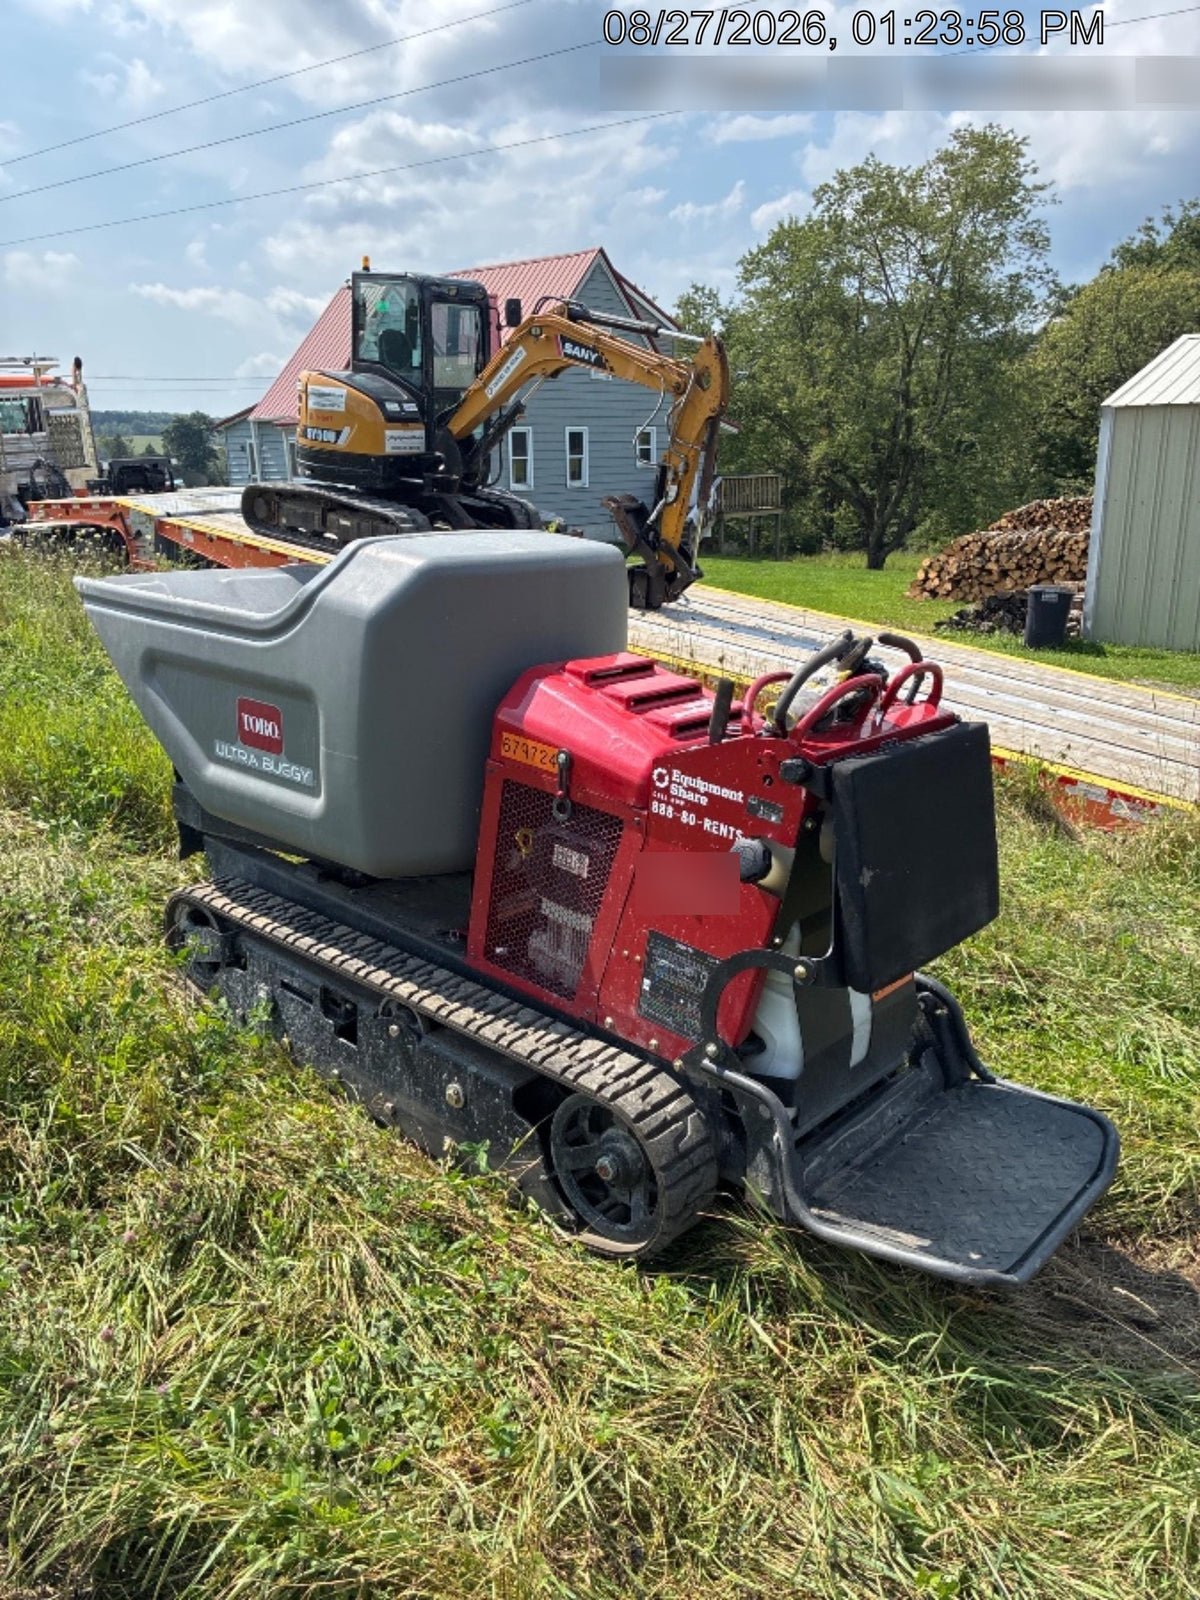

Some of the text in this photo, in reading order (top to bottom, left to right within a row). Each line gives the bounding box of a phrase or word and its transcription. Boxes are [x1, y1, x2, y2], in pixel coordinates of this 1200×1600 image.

[564, 342, 599, 362] SANY
[241, 713, 281, 739] TORO
[215, 741, 313, 785] ULTRA BUGGY
[503, 737, 558, 768] 679724
[670, 783, 709, 806] Share
[671, 769, 744, 803] Equipment
[651, 801, 744, 841] 888-80-RENTS
